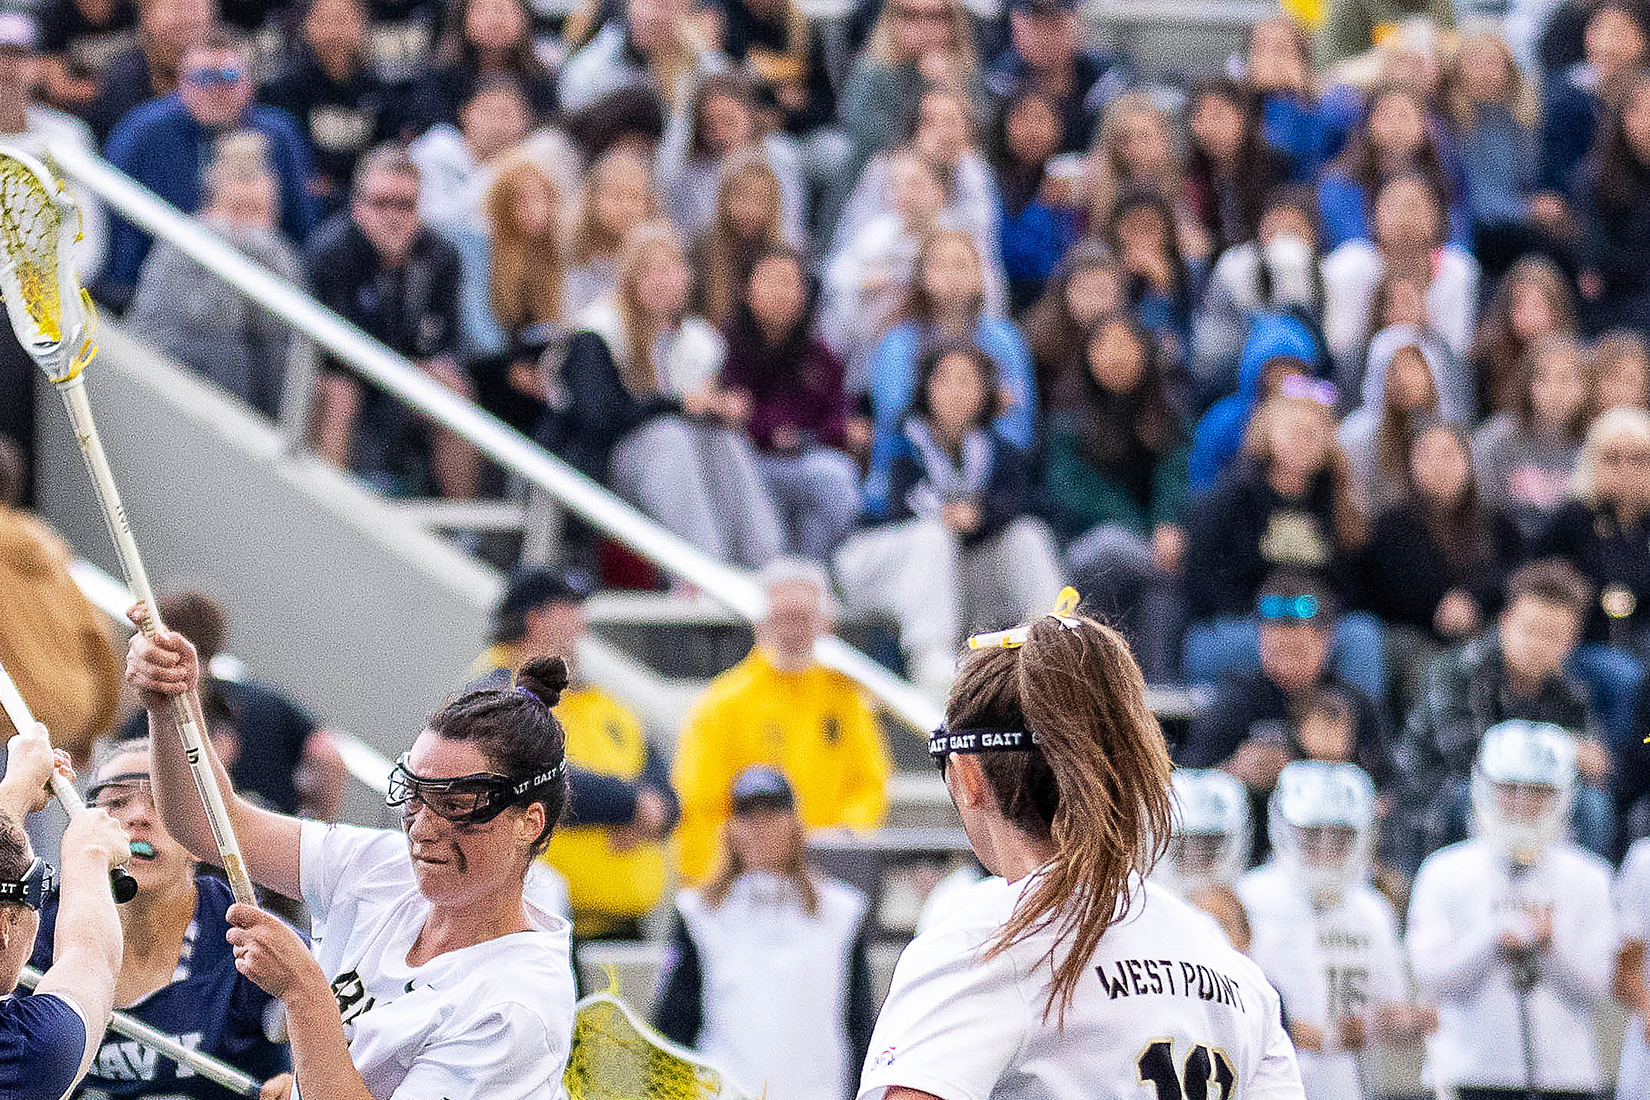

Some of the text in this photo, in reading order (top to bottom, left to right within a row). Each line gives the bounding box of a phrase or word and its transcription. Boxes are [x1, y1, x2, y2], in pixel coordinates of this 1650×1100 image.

[928, 737, 948, 754] AIT
[949, 733, 977, 750] GAIT
[981, 732, 1022, 747] GAIT
[533, 767, 558, 786] GAIT
[1095, 959, 1246, 1014] WEST POINT
[88, 1032, 203, 1081] AVY
